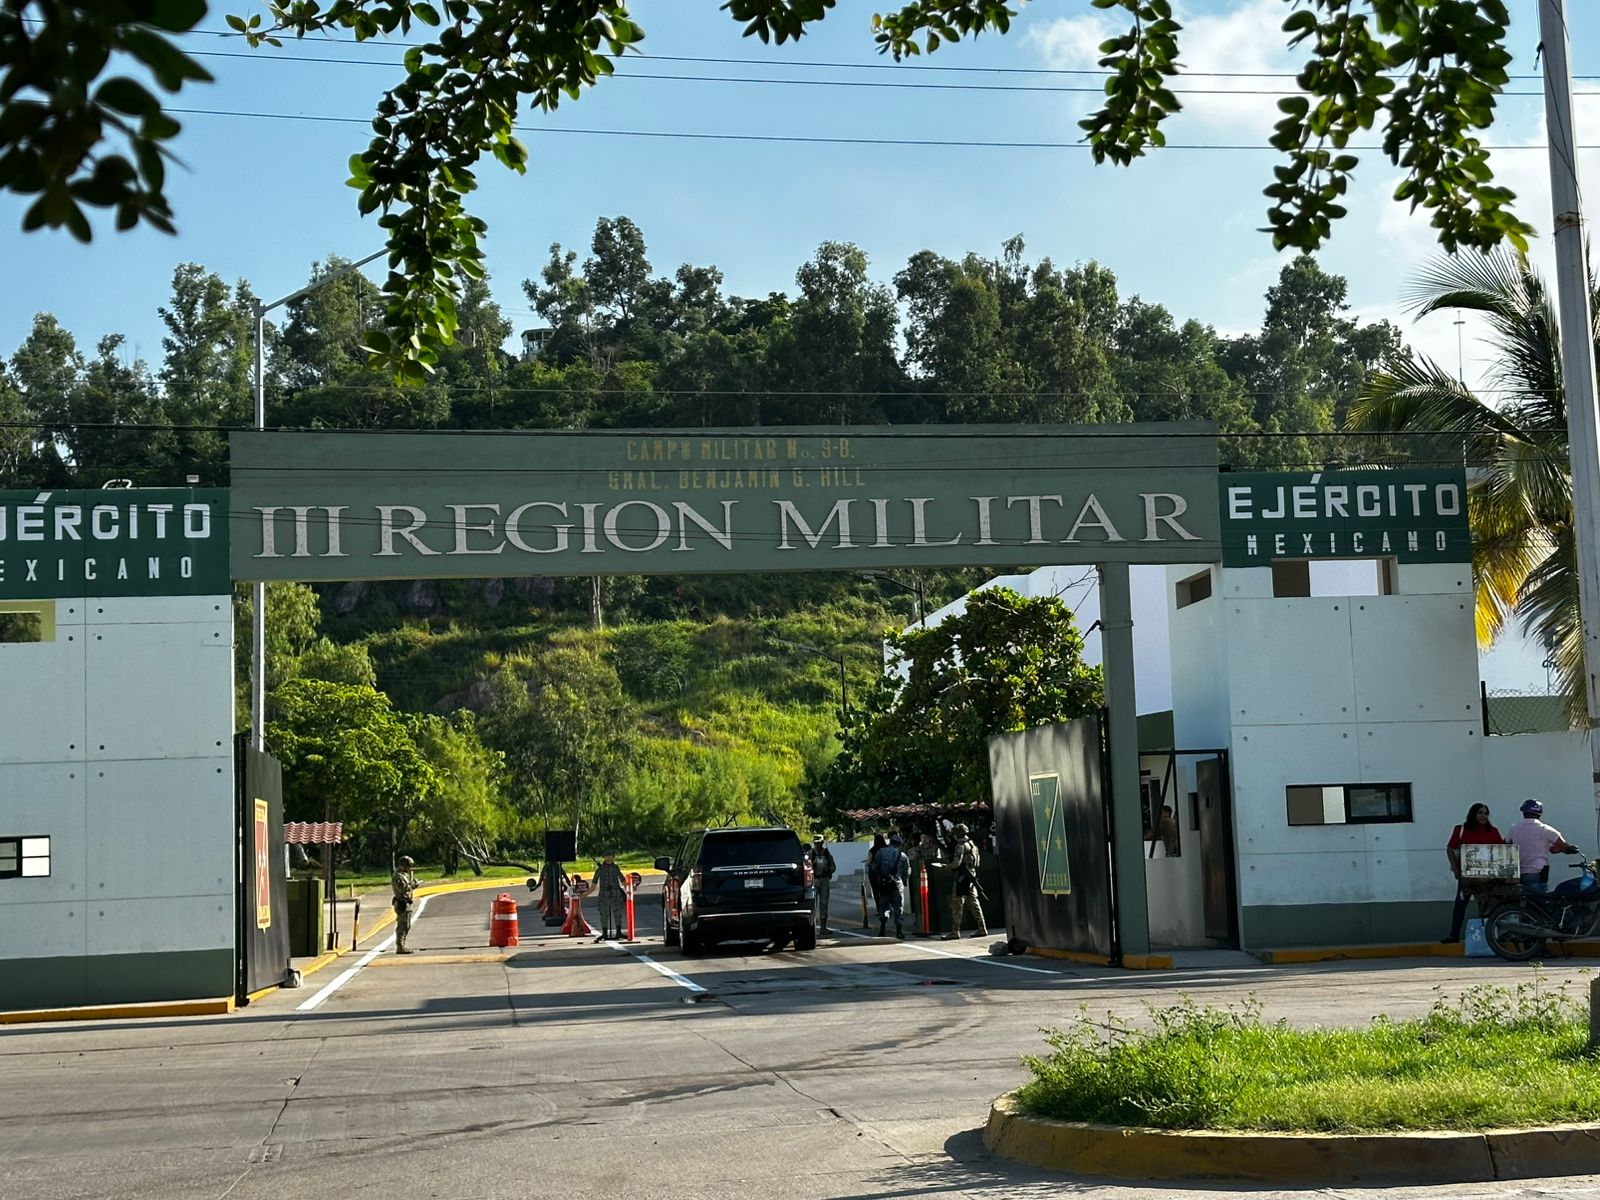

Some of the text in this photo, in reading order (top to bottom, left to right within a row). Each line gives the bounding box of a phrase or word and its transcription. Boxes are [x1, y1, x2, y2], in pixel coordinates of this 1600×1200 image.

[626, 439, 692, 461] CAMPO
[701, 438, 777, 460] MILITAR
[792, 466, 811, 488] G.
[1228, 473, 1460, 520] EJÉRCITO
[252, 493, 1203, 558] III REGION MILITAR
[1247, 530, 1446, 556] MEXICANO
